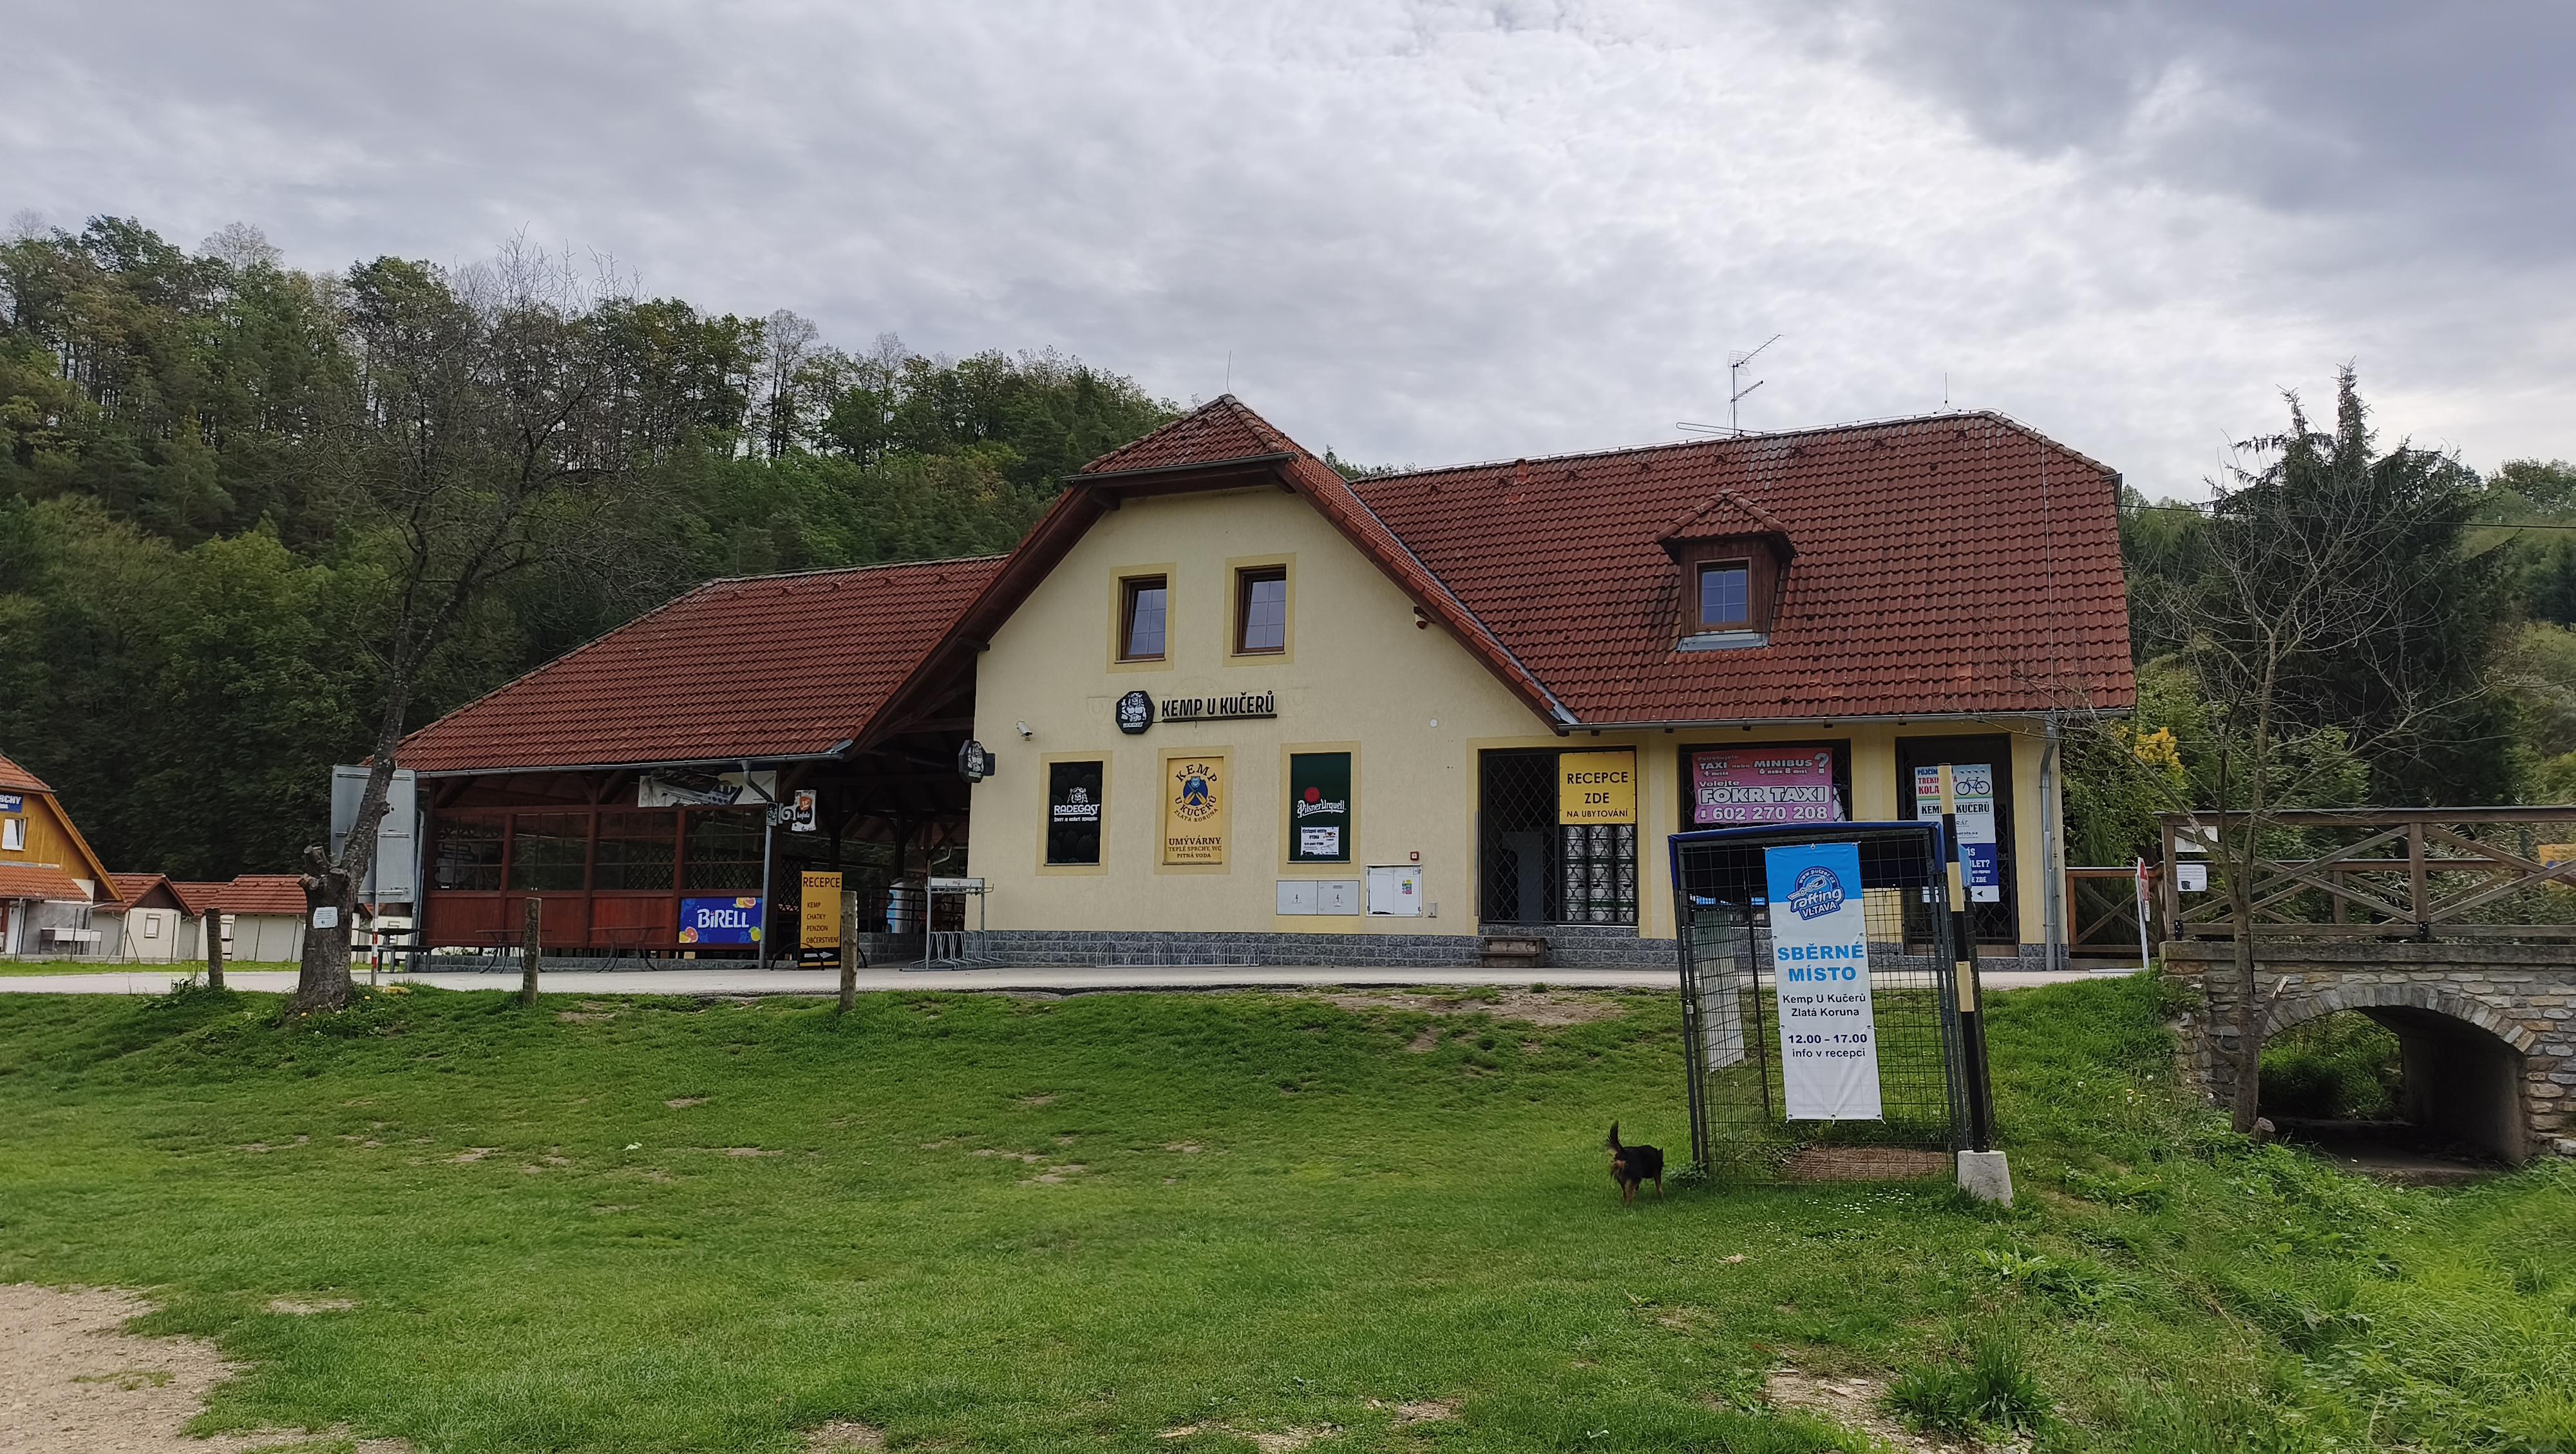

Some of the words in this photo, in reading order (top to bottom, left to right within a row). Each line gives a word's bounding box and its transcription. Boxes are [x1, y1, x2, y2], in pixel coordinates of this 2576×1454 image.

[1162, 699, 1203, 717] KEMP
[1207, 698, 1216, 715] U
[1220, 690, 1274, 714] KUČERŮ
[1700, 762, 1727, 770] TAXI
[1754, 759, 1813, 768] MINIBUS
[1175, 763, 1217, 782] KEMP
[1567, 771, 1628, 784] RECEPCE
[1700, 788, 1766, 804] FOKR
[1771, 787, 1825, 802] TAXI
[1918, 786, 1940, 794] KOLA
[1584, 793, 1609, 804] ZDE
[1054, 804, 1100, 816] RADEGAST
[1175, 795, 1182, 805] U
[1180, 795, 1217, 817] KUČERŮ
[1297, 800, 1321, 818] Pilsner
[1321, 798, 1345, 813] Urquell
[1582, 807, 1629, 817] UBYTOVÁNÍ
[1174, 809, 1191, 822] ZLATÁ
[1194, 808, 1218, 822] KORUNA
[1712, 807, 1747, 820] 602
[1752, 806, 1786, 820] 270
[1792, 806, 1828, 820] 208
[1168, 835, 1221, 845] UMÝVÁRNY
[802, 877, 840, 888] RECEPCE
[1799, 869, 1836, 883] www.putzer.cz
[1803, 902, 1837, 917] VLTAVA
[1777, 941, 1864, 961] SBĚRNÉ
[1788, 965, 1856, 981] MÍSTO
[1783, 995, 1814, 1005] Kemp
[1816, 994, 1824, 1003] U
[1828, 993, 1866, 1003] Kučerů
[1791, 1008, 1817, 1017] Zlatá
[1820, 1008, 1859, 1017] Koruna
[1788, 1034, 1821, 1044] 12.00
[1833, 1034, 1868, 1043] 17.00
[1792, 1048, 1813, 1057] info
[1826, 1048, 1866, 1059] recepci
